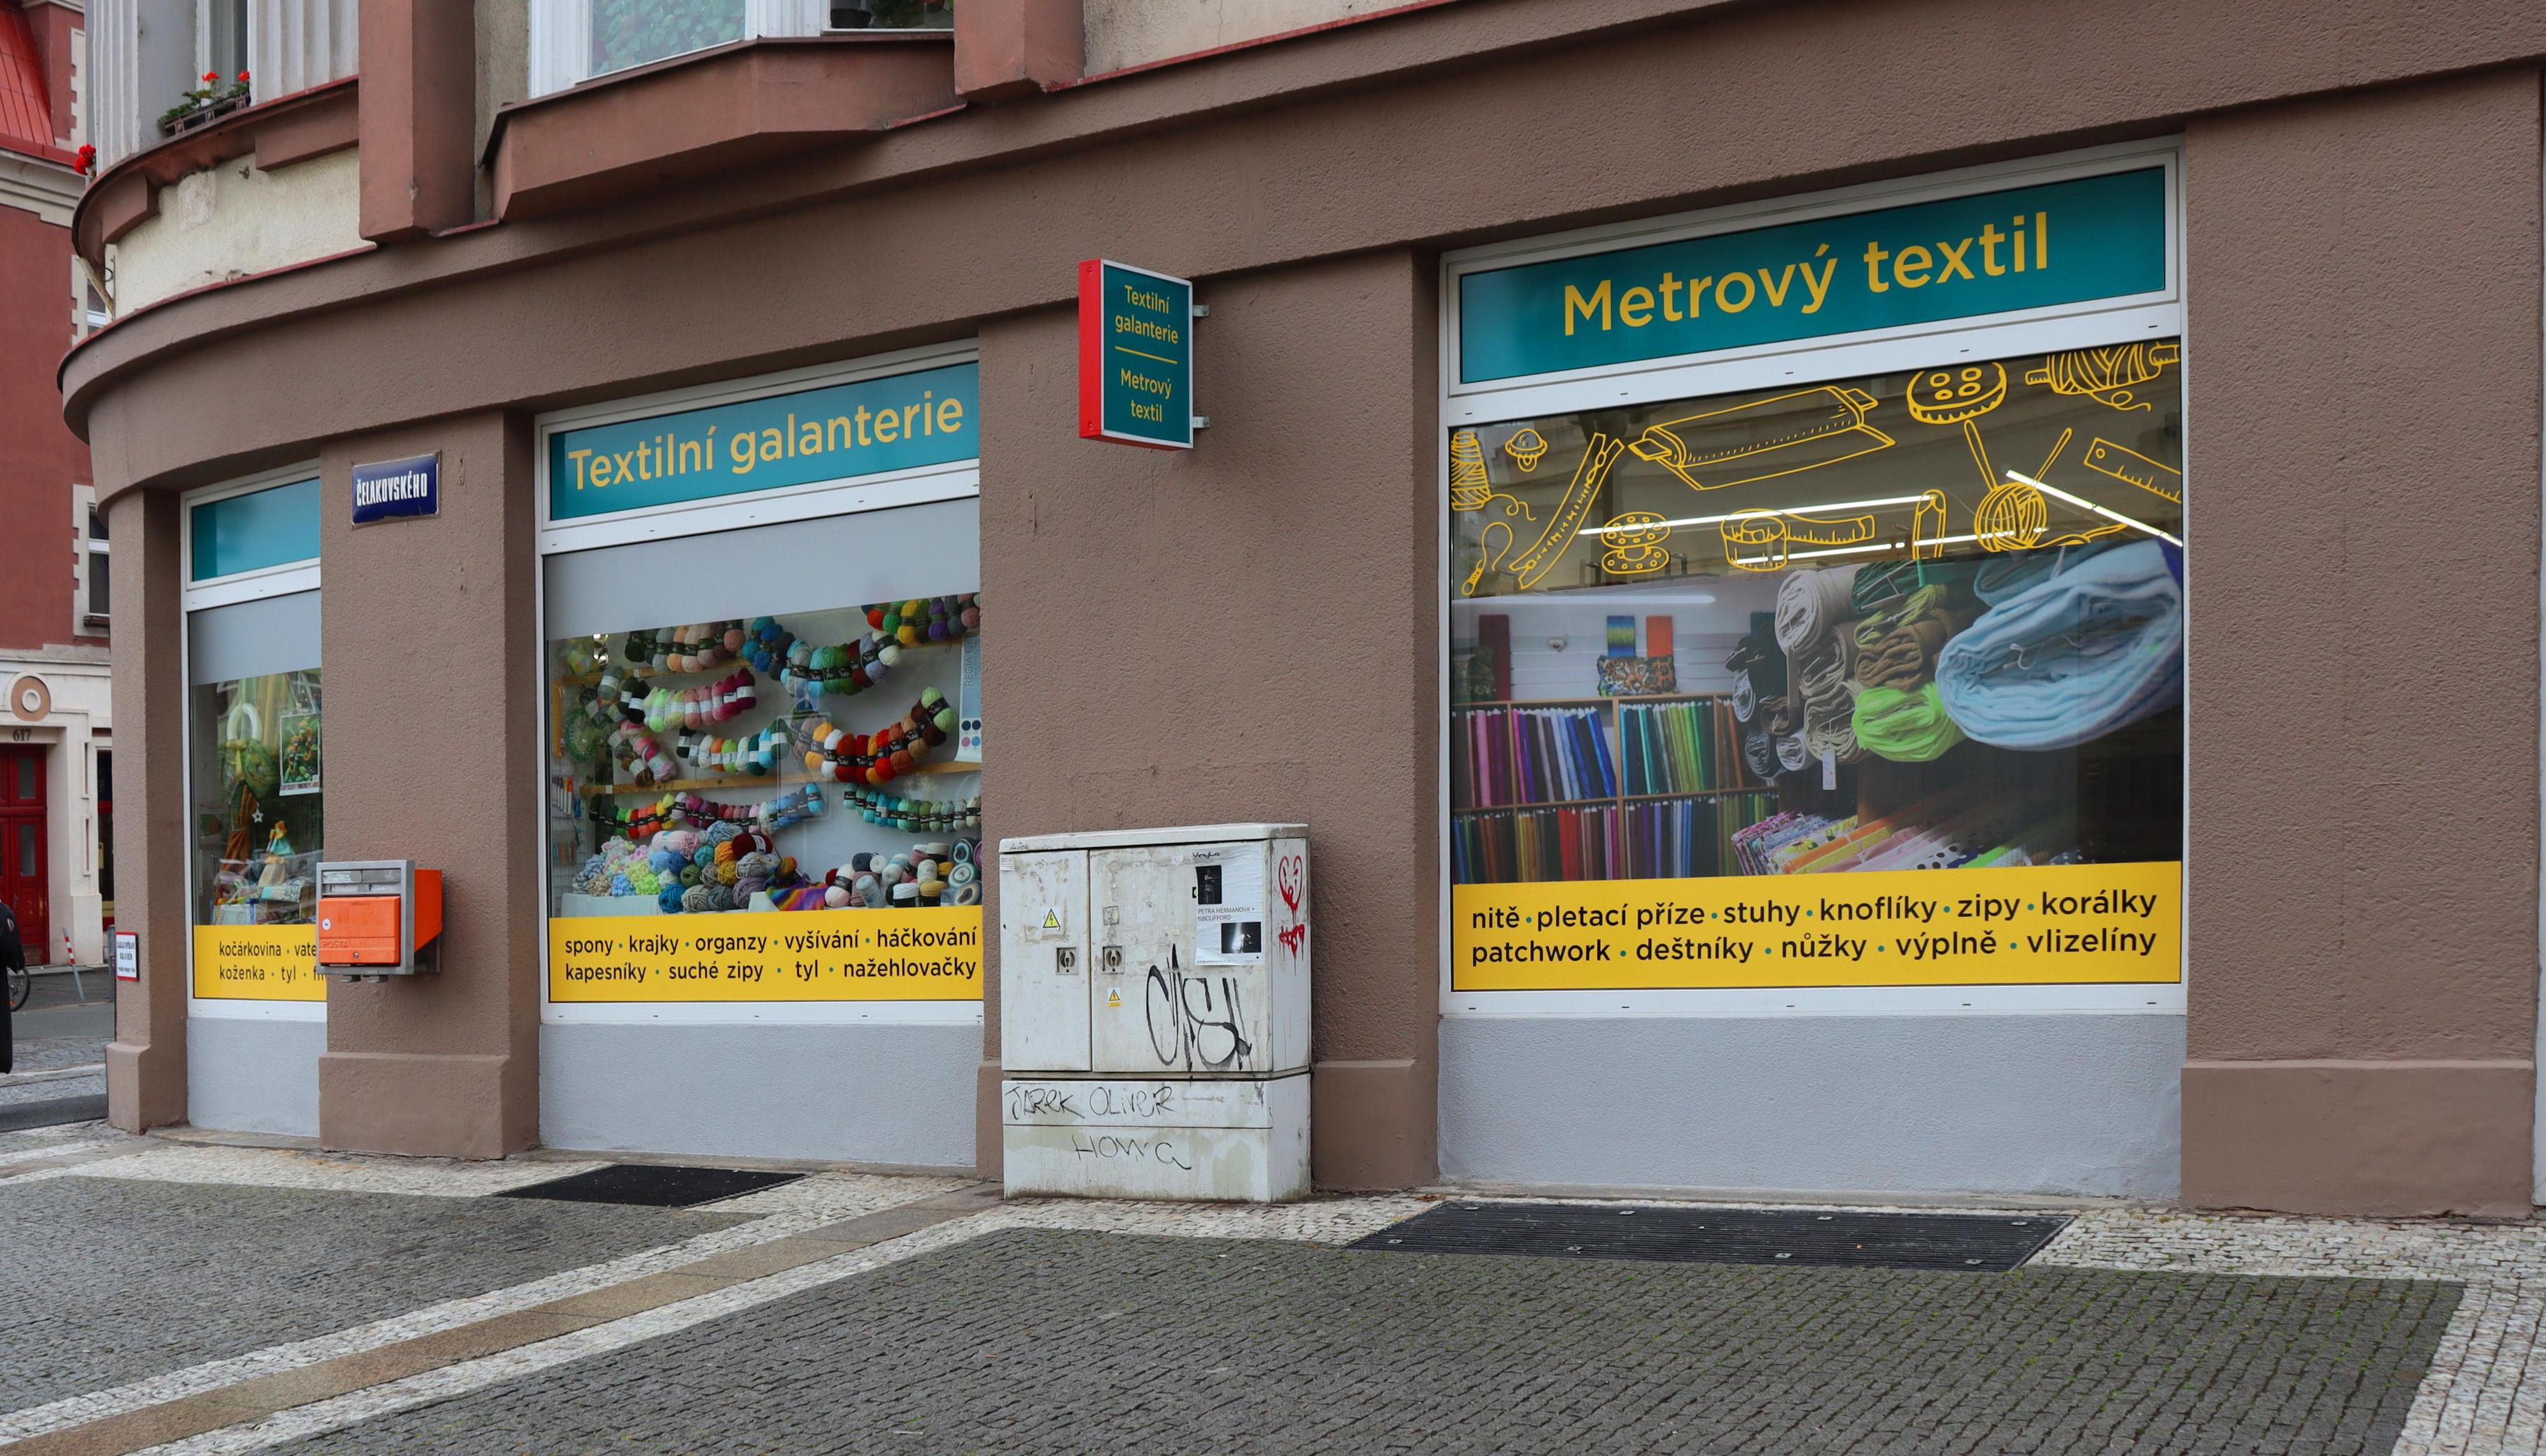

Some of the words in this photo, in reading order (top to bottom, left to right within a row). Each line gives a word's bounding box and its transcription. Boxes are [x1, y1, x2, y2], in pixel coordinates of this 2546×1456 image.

[1565, 243, 1838, 336] Metrový
[1863, 211, 2048, 293] textil
[1125, 284, 1170, 314] Textilní
[1115, 315, 1178, 344] galanterie
[1120, 368, 1172, 400] Metrový
[1130, 400, 1163, 422] textil
[569, 426, 716, 490] Textilní
[731, 391, 963, 474] galanterie
[356, 470, 428, 507] ČELAKOVSKÉHO
[13, 728, 31, 741] 617
[1472, 906, 1520, 929] nitě
[1537, 902, 1629, 932] pletací
[1637, 902, 1705, 930] příze
[1723, 899, 1801, 927] stuhy
[1820, 895, 1938, 923] knoflíky
[1957, 893, 2021, 922] zipy
[2042, 888, 2158, 918] korálky
[219, 941, 281, 956] kočárkovina
[565, 939, 614, 957] spony
[629, 934, 679, 956] krajky
[695, 936, 768, 955] organzy
[784, 928, 860, 953] vyšívání
[877, 925, 977, 948] háčkování
[1472, 939, 1611, 967] patchwork
[1636, 935, 1754, 964] deštníky
[1782, 932, 1867, 962] nůžky
[1895, 929, 1997, 960] výplně
[2026, 927, 2157, 956] vlizelíny
[220, 964, 265, 981] koženka
[281, 965, 296, 984] tyl
[565, 962, 647, 984] kapesníky
[669, 960, 719, 980] suché
[727, 960, 764, 983] zipy
[795, 959, 819, 982] tyl
[843, 956, 977, 980] nažehlovačky
